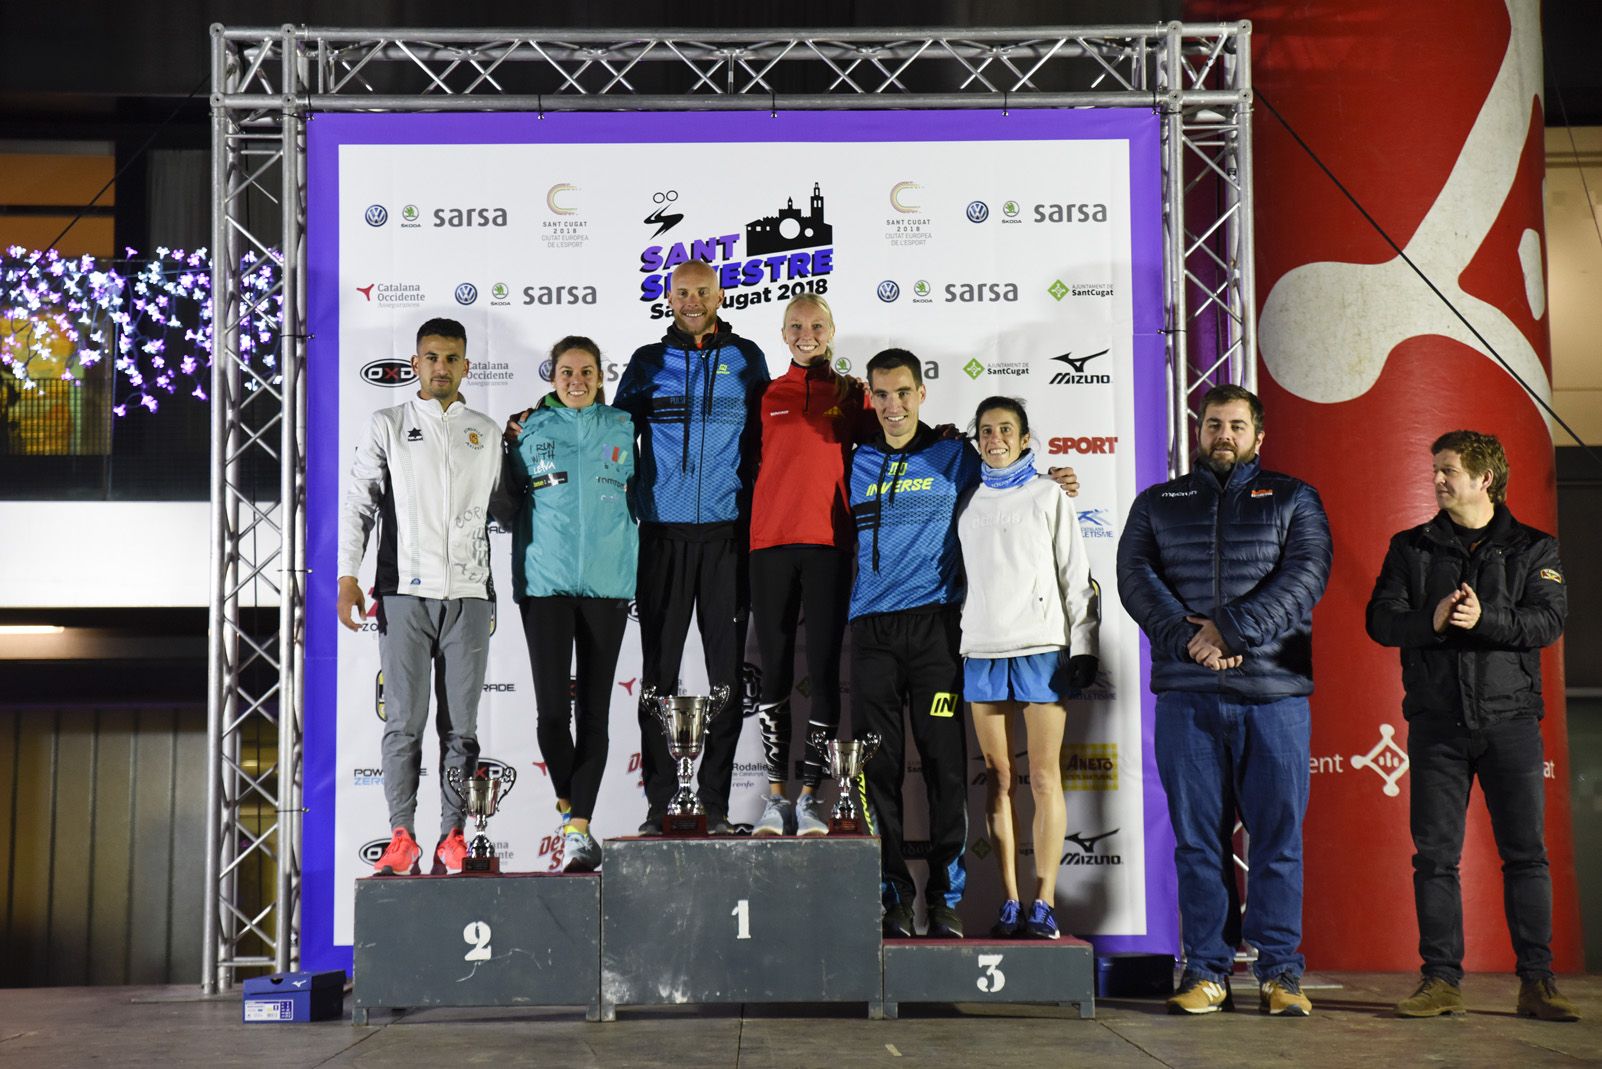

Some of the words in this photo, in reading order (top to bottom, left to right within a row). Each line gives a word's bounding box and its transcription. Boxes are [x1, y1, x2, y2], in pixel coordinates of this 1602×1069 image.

[433, 207, 508, 228] sarsa
[1034, 203, 1107, 223] sarsa
[640, 233, 740, 272] SANT
[377, 283, 421, 292] Catalana
[523, 286, 597, 305] sarsa
[722, 287, 772, 311] ugat
[777, 279, 828, 300] 2018
[944, 283, 1018, 302] sarsa
[1072, 289, 1114, 297] SantCugat
[377, 293, 426, 302] Occidente
[368, 367, 415, 382] OXD
[987, 367, 1030, 376] SantCugat
[1049, 372, 1110, 384] MIZUNO
[536, 440, 555, 451] RUN
[1048, 436, 1118, 455] SPORT
[866, 477, 935, 496] INVERSE
[732, 762, 769, 772] Rodalie
[1067, 754, 1113, 770] ANETO
[1060, 852, 1121, 865] MIZUNO
[731, 900, 751, 940] 1
[463, 921, 492, 962] 2
[976, 954, 1005, 993] 3
